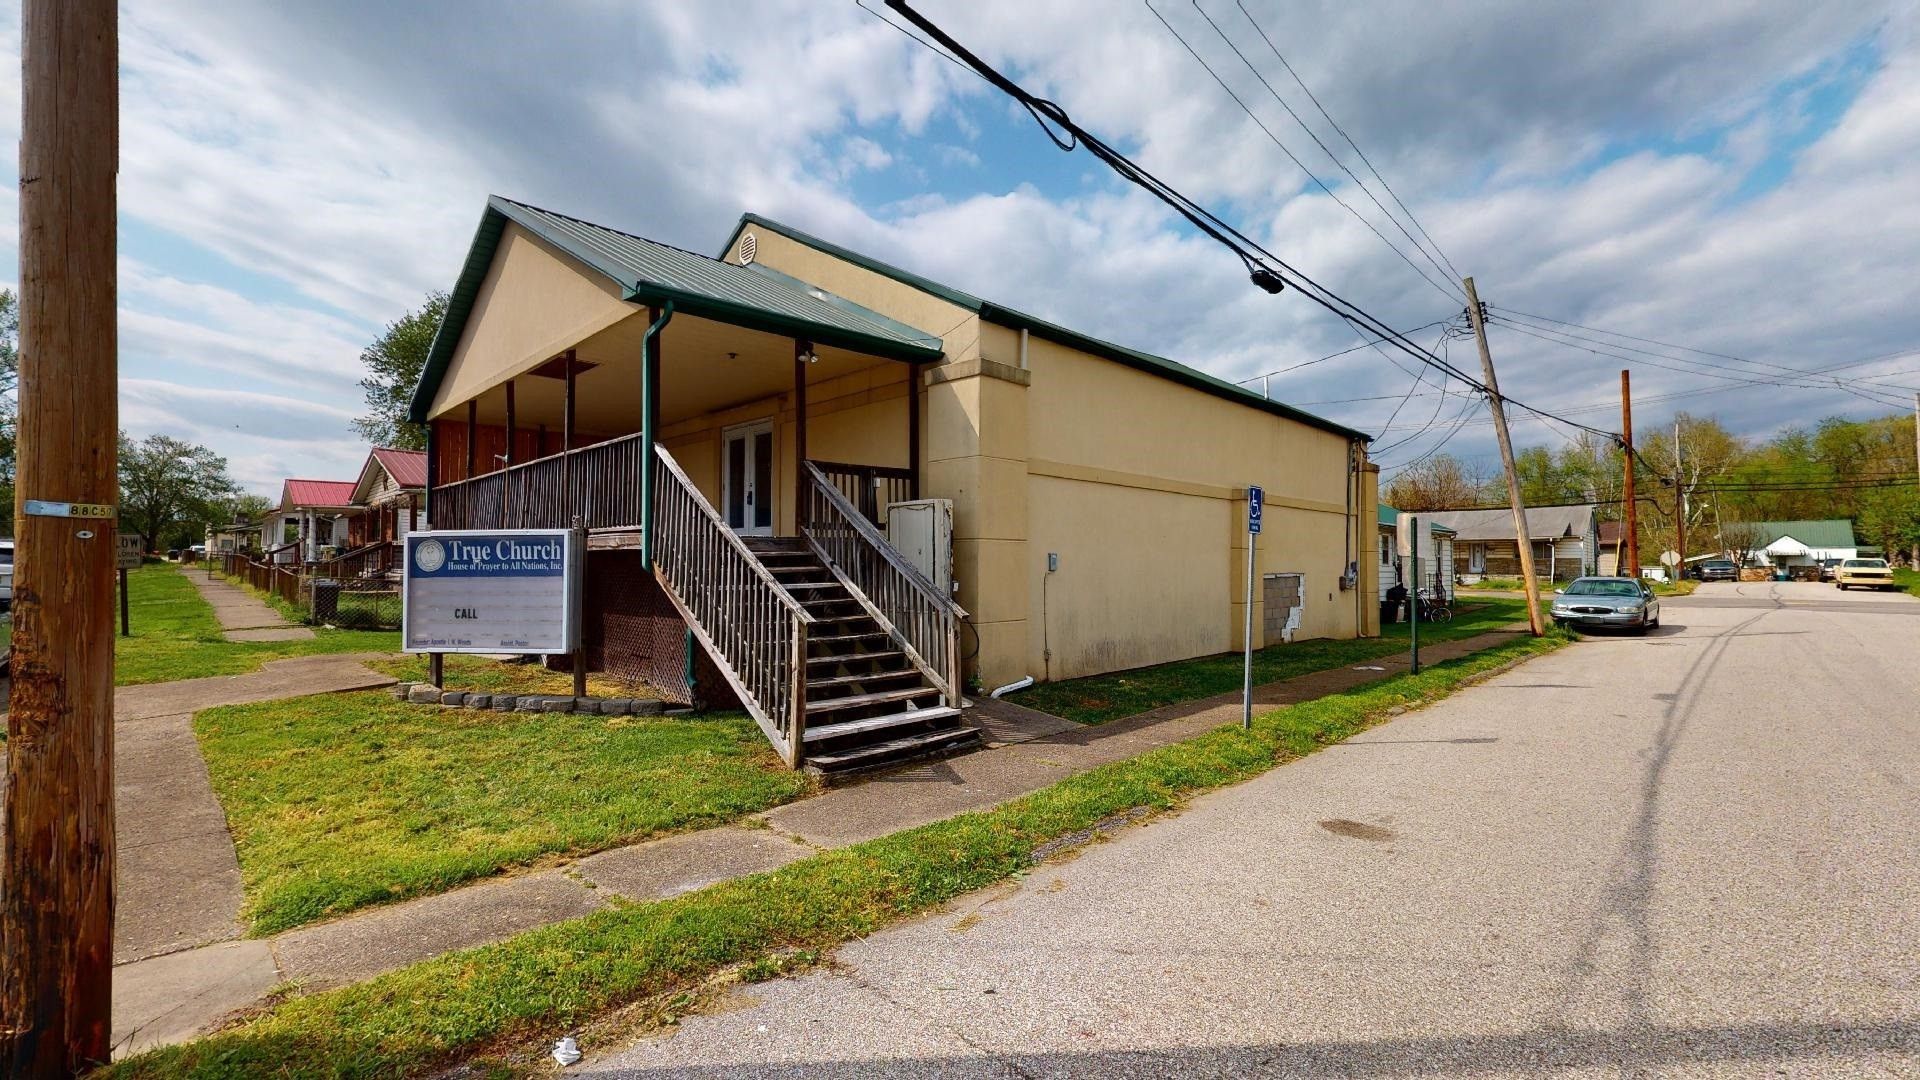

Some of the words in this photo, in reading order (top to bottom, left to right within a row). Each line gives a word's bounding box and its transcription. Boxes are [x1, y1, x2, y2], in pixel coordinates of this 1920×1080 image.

[449, 540, 491, 560] True
[496, 539, 561, 560] Church
[448, 561, 468, 570] House
[470, 561, 477, 570] of
[478, 561, 500, 573] Prayer
[502, 562, 509, 570] to
[510, 561, 521, 570] All
[522, 561, 549, 571] Nations,
[550, 561, 563, 570] Inc.
[454, 608, 478, 619] CALL
